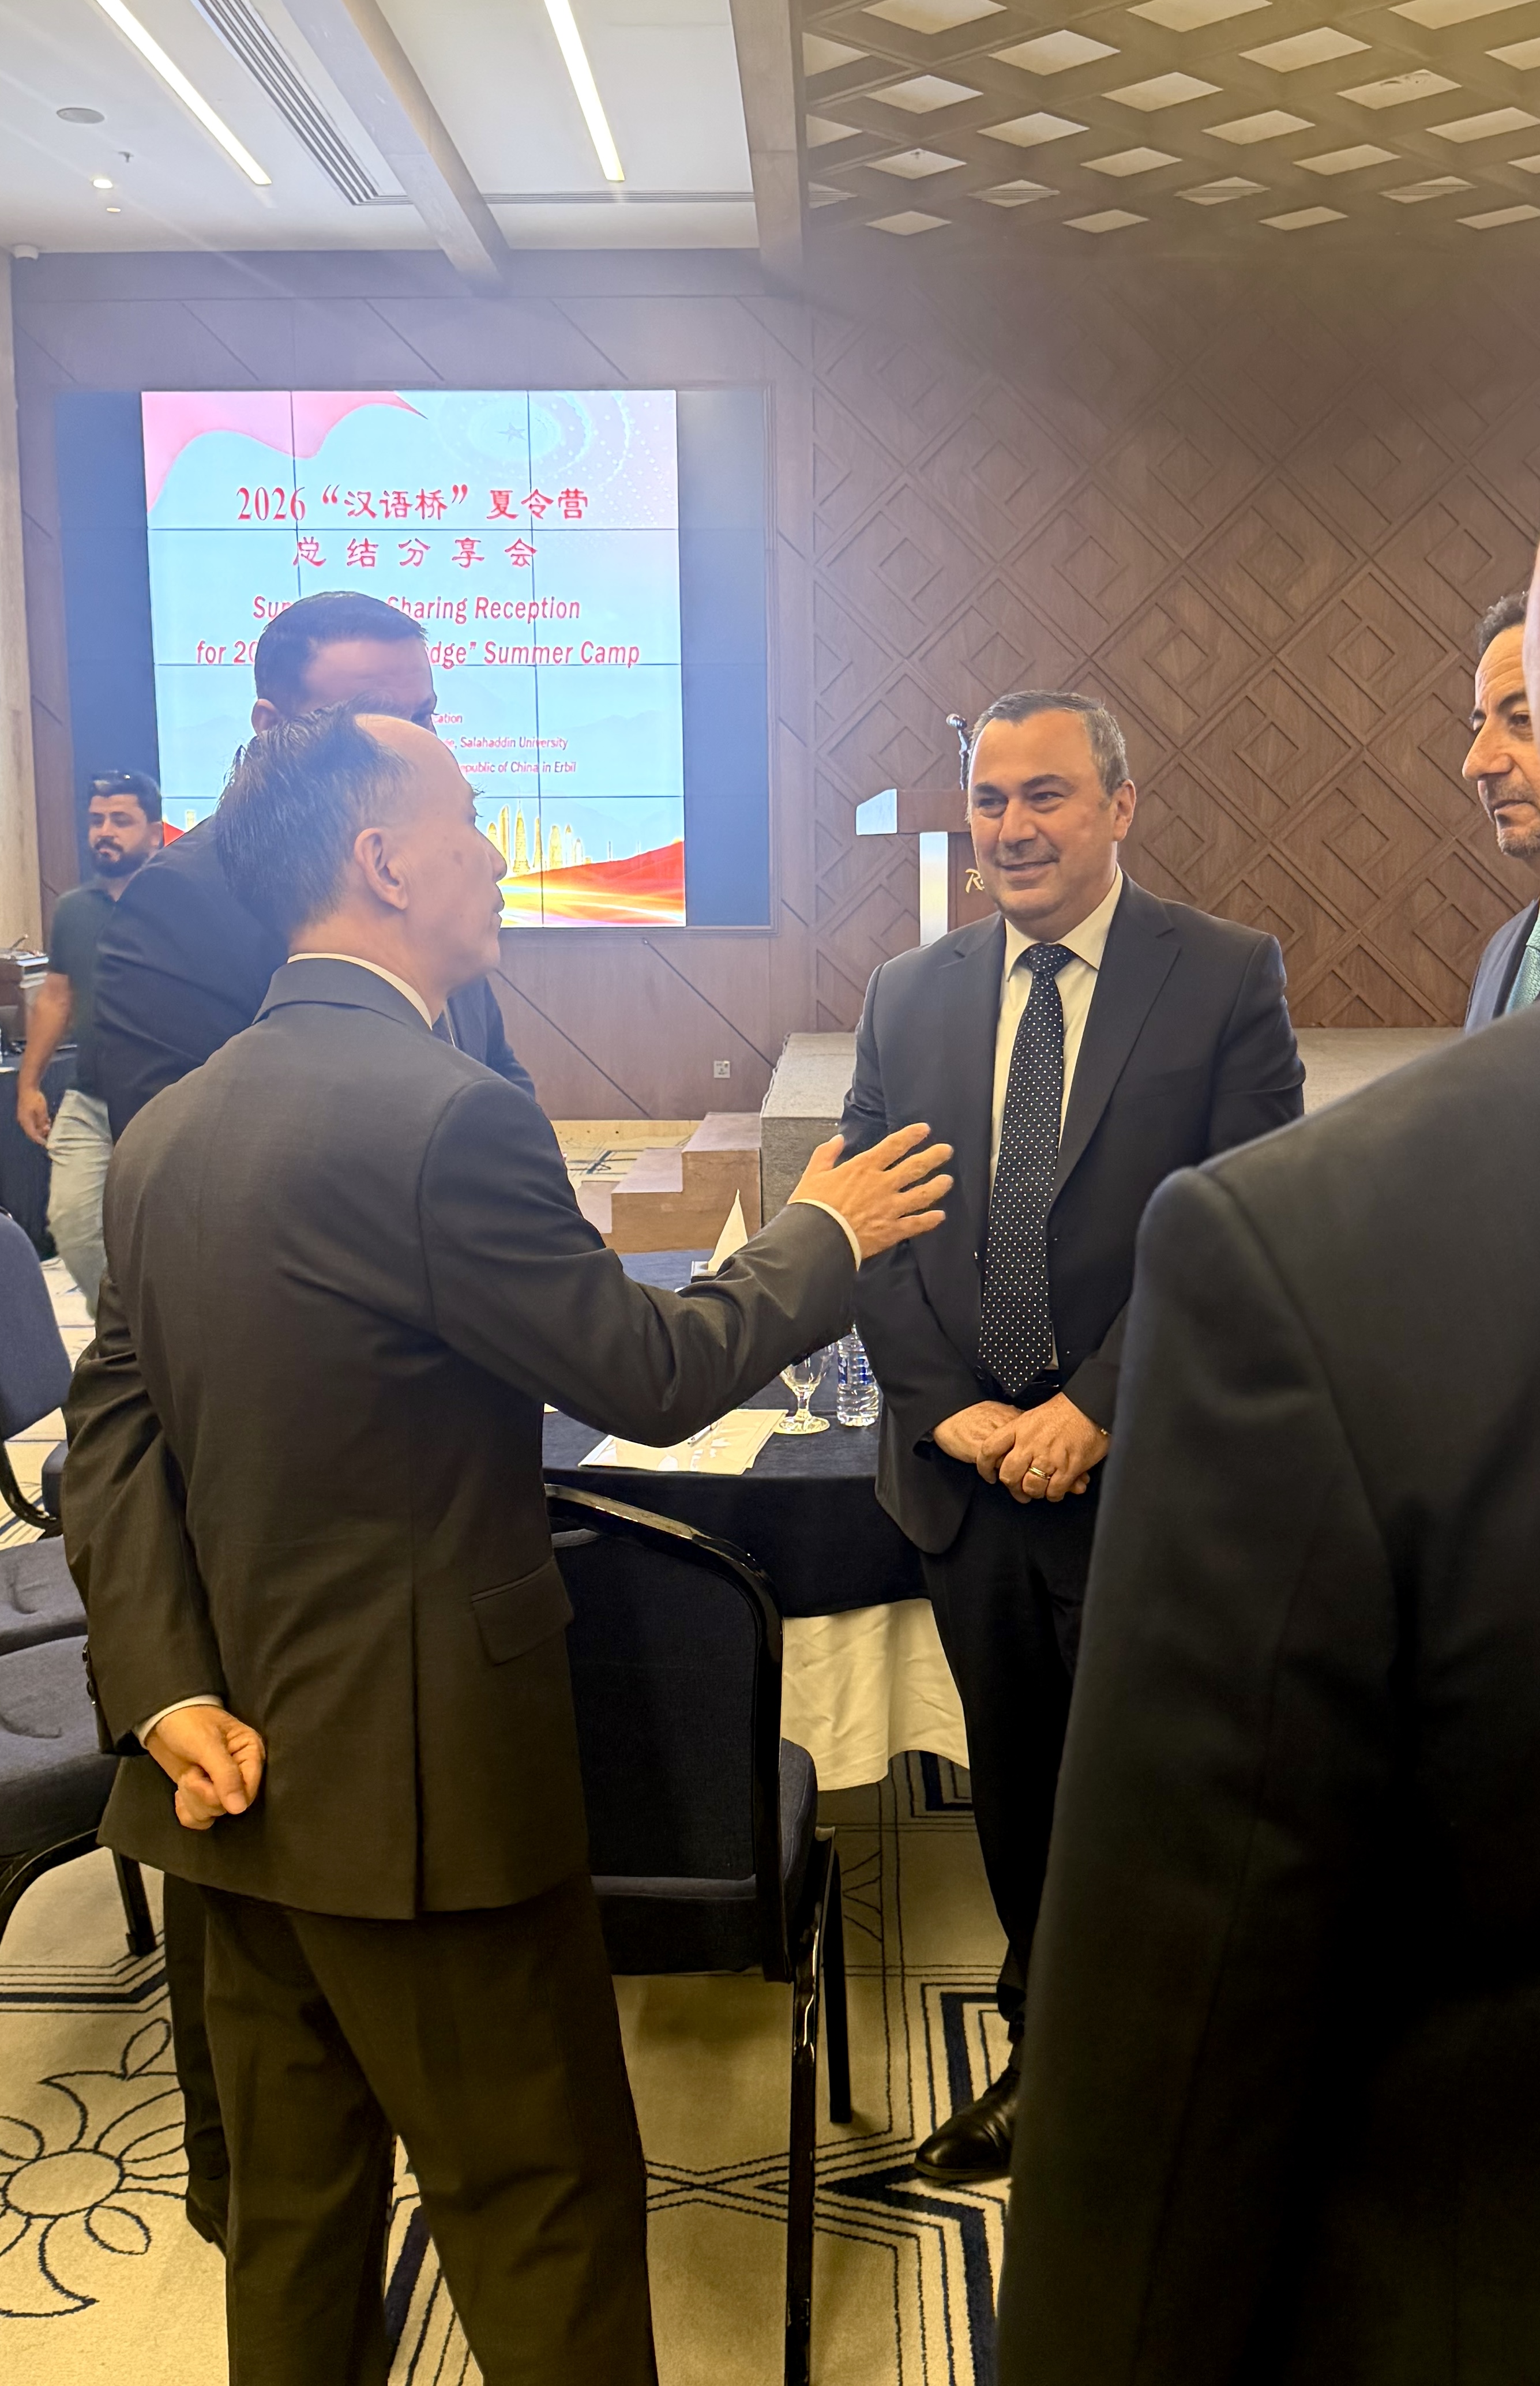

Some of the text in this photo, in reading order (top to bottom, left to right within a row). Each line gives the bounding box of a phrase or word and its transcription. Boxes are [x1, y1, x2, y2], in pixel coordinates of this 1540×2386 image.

[475, 596, 580, 625] Reception
[197, 640, 227, 664] for
[484, 641, 573, 664] Summer
[580, 640, 640, 669] Camp
[460, 737, 516, 748] Salahaddin
[519, 737, 568, 750] University
[498, 761, 508, 773] of
[510, 761, 538, 773] China
[542, 761, 551, 773] in
[554, 761, 577, 773] Erbil
